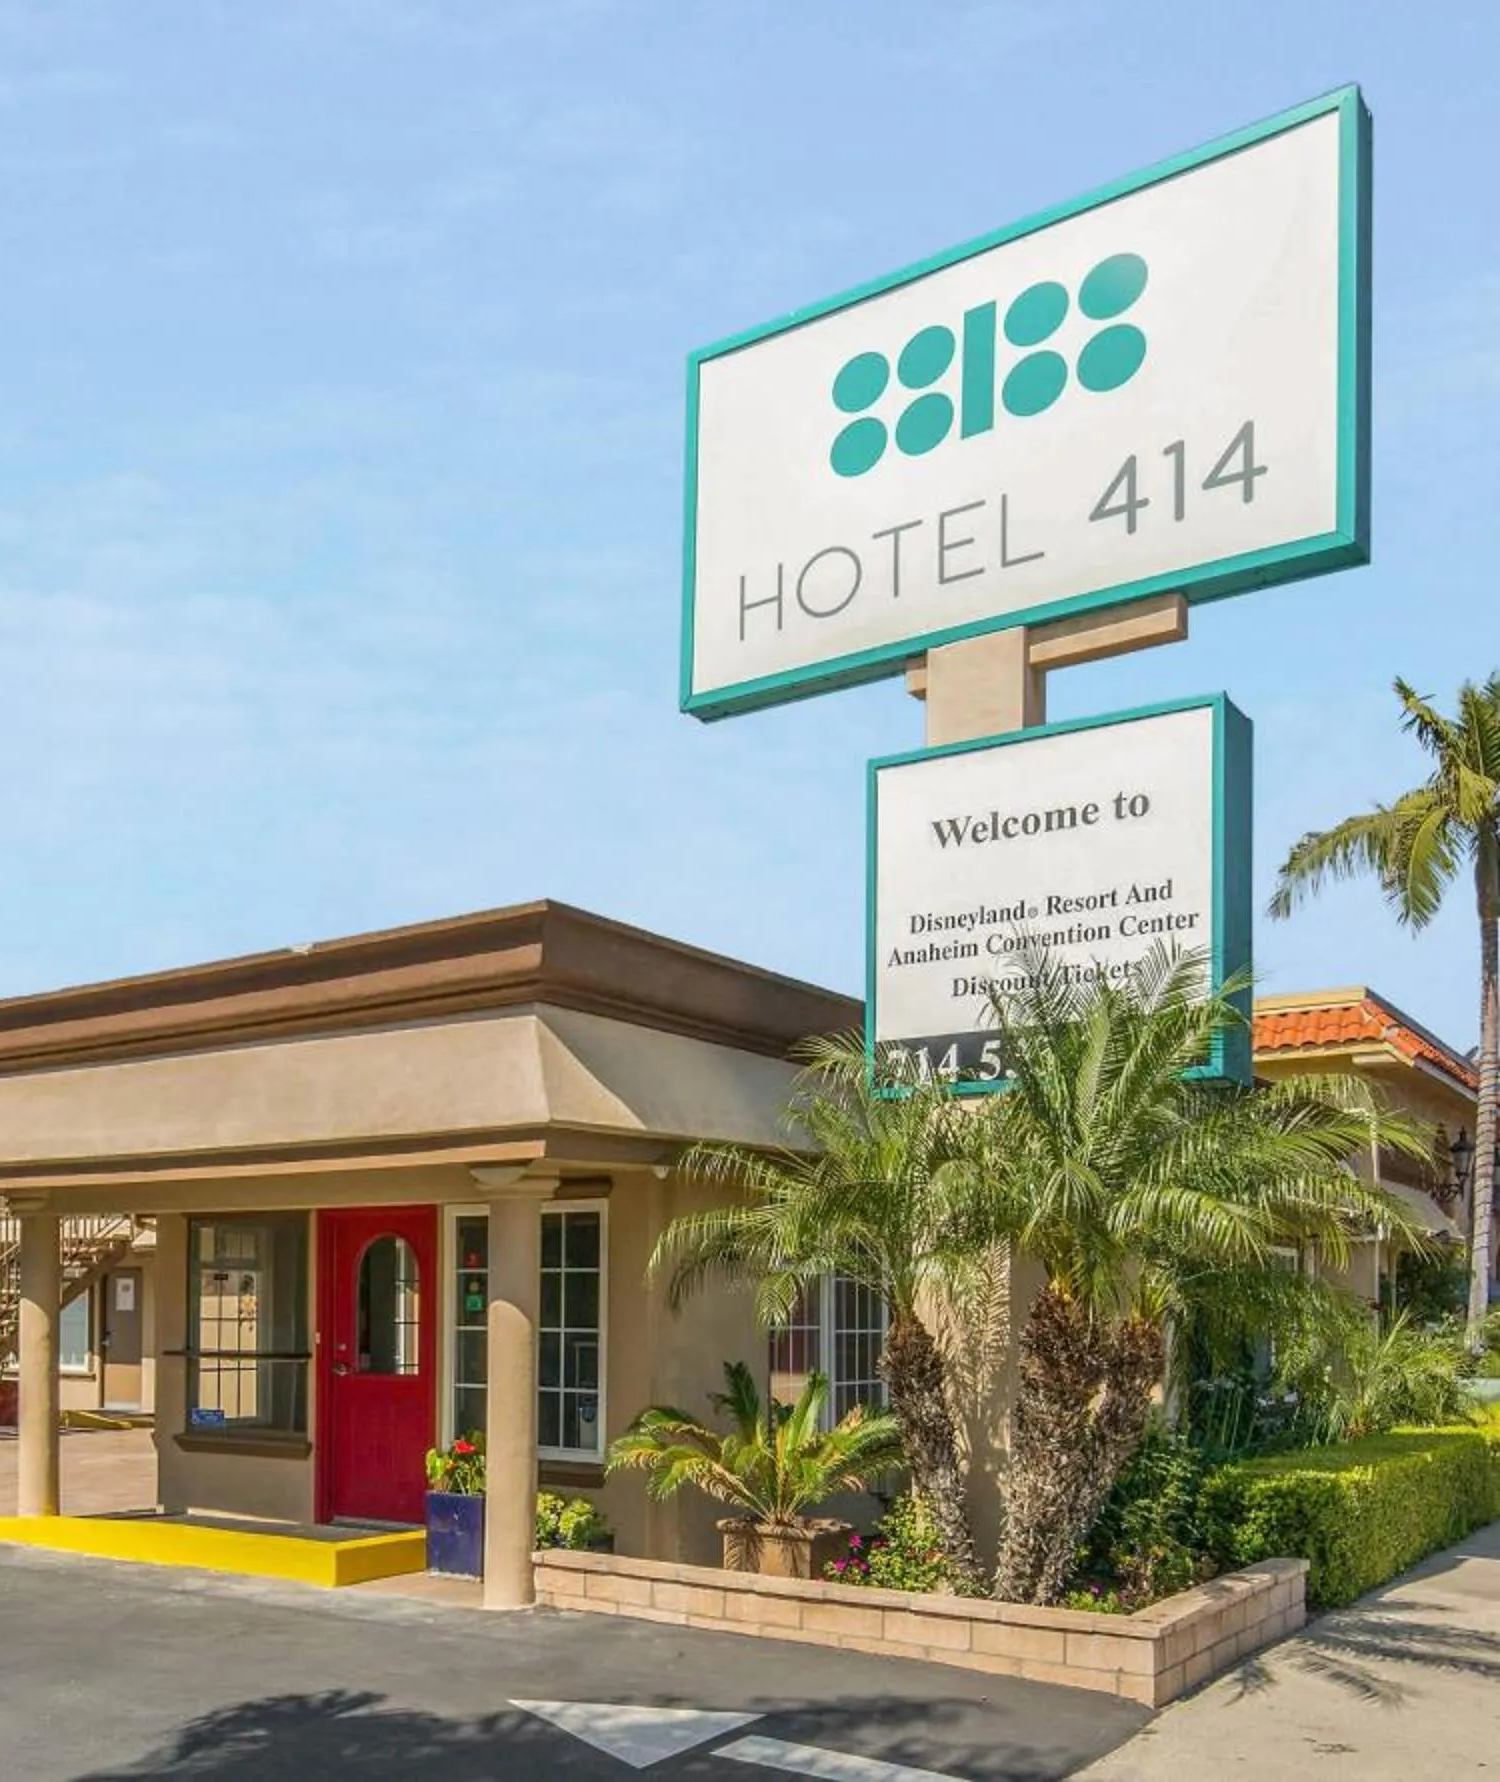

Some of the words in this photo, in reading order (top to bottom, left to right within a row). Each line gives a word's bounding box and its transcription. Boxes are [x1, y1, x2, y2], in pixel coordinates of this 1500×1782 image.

[739, 494, 1045, 641] HOTEL
[1088, 421, 1268, 535] 414
[931, 802, 1100, 850] Welcome
[1114, 791, 1151, 819] to
[1046, 889, 1119, 917] Resort
[1124, 879, 1174, 905] And
[887, 939, 979, 967] Anaheim
[986, 922, 1112, 956] Convention
[1119, 911, 1200, 938] Center
